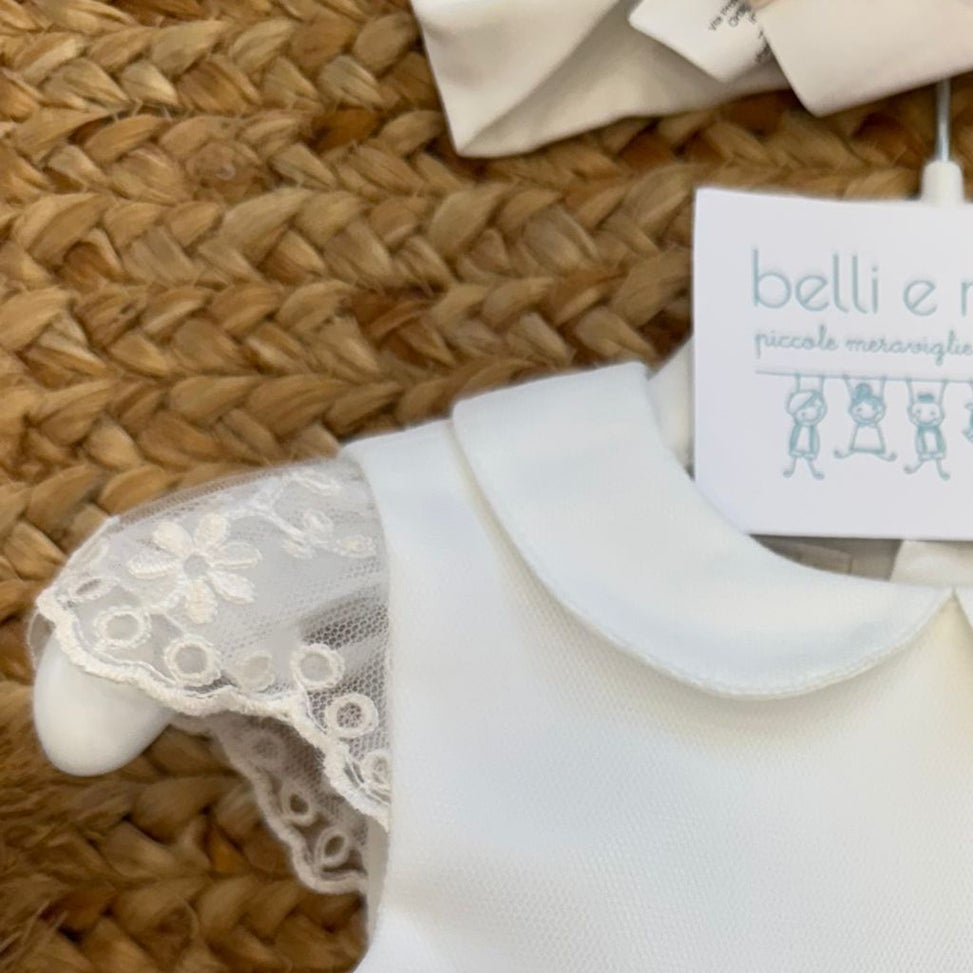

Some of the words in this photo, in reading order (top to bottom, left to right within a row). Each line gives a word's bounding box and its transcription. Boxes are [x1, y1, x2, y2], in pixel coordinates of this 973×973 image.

[751, 247, 880, 315] belli
[902, 277, 938, 317] e
[753, 323, 840, 360] piccole
